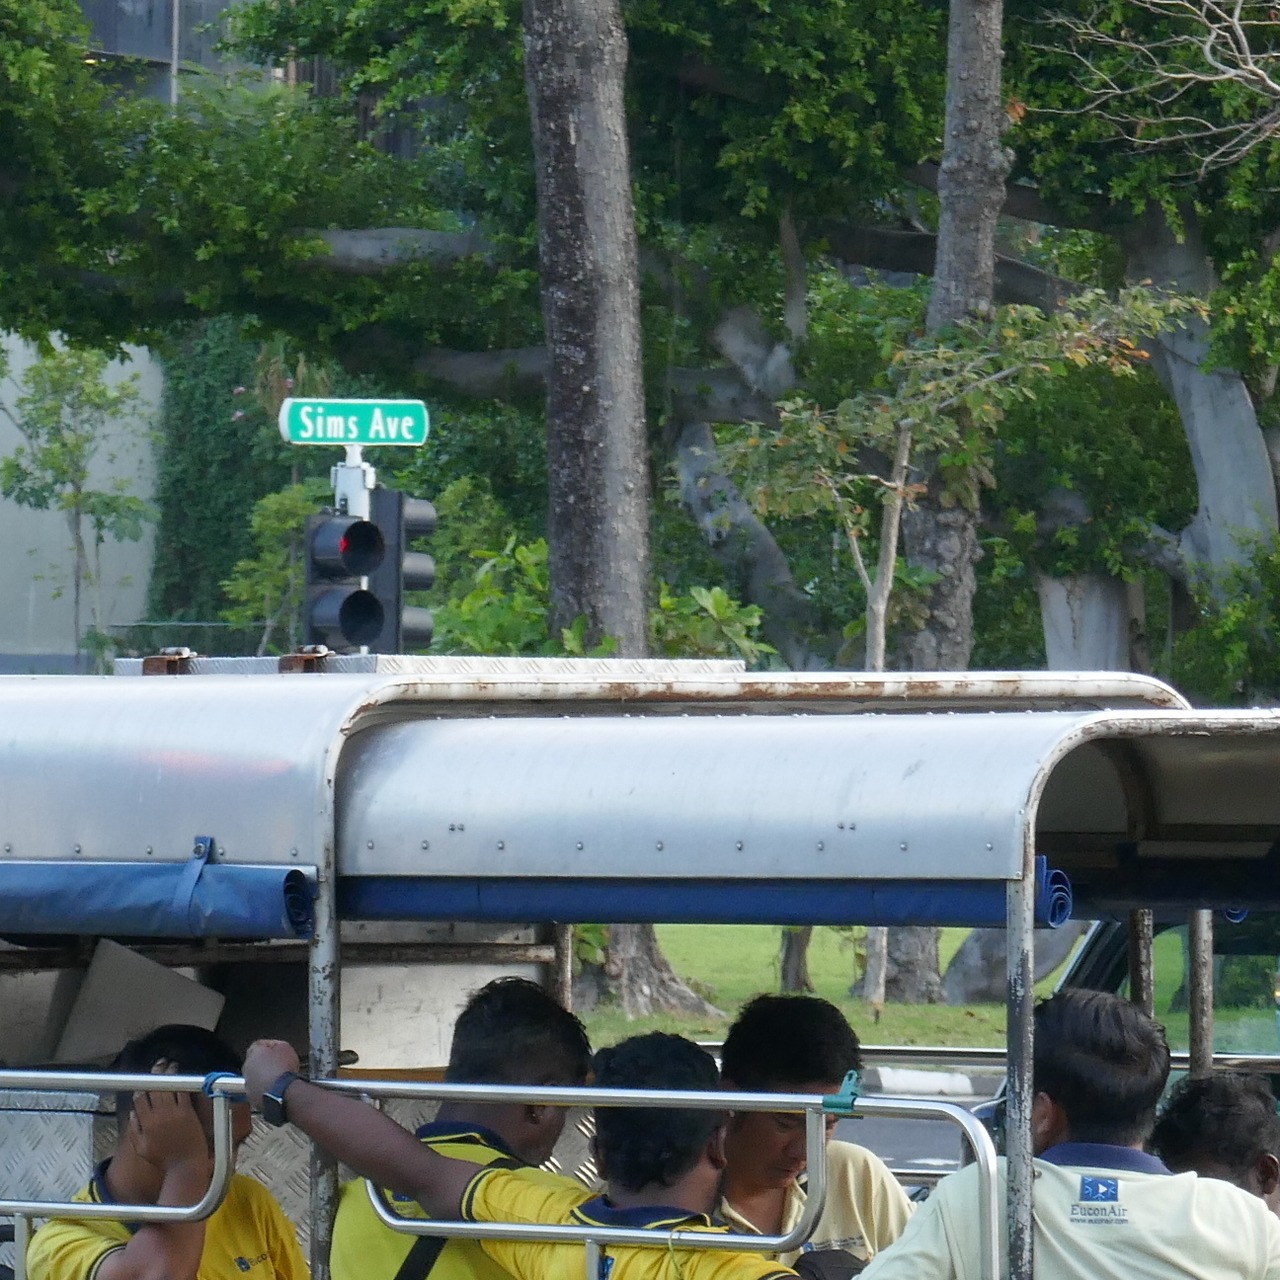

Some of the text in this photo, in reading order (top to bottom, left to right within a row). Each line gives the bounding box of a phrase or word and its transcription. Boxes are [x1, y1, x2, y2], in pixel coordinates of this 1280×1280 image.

[299, 406, 414, 440] Sims Ave
[1070, 1204, 1128, 1217] EuconAir
